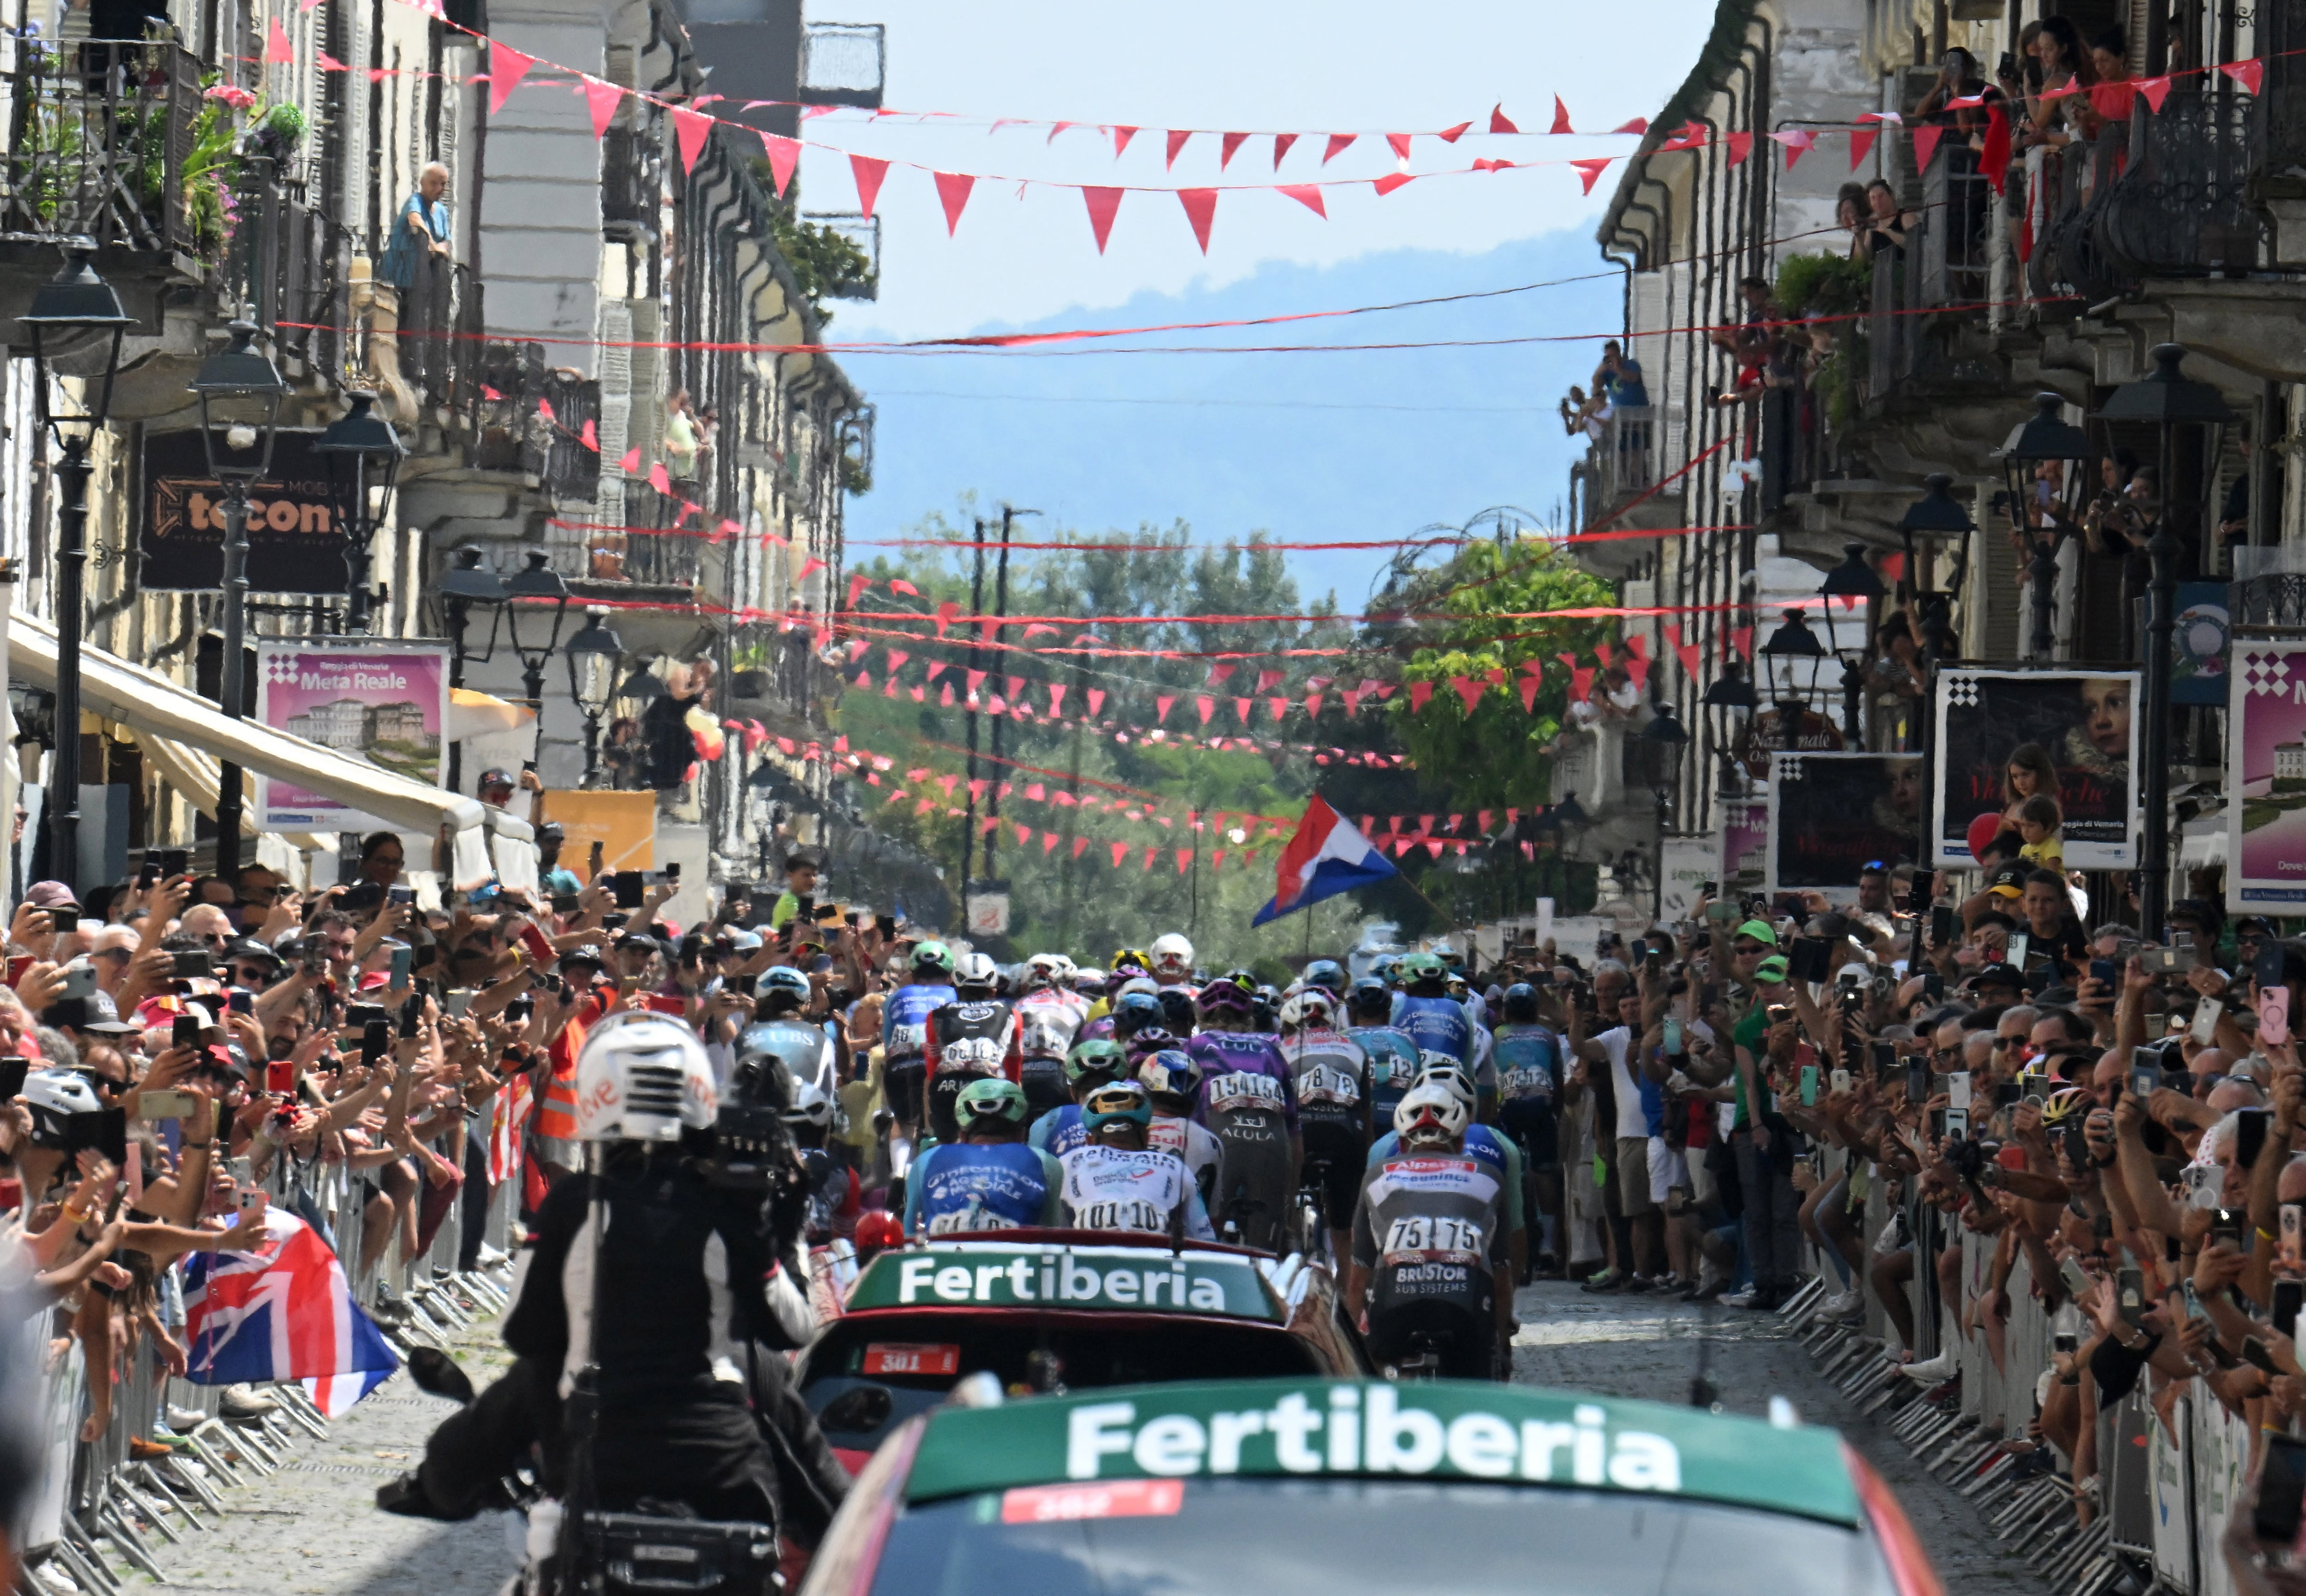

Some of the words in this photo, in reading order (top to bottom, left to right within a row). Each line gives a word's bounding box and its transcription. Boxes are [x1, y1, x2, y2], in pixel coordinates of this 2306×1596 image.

[301, 672, 350, 689] Meta
[355, 672, 406, 689] Reale
[770, 1030, 815, 1046] UBS
[1213, 1076, 1248, 1102] 154
[1304, 1068, 1323, 1092] 78
[1222, 1127, 1275, 1141] ALULA
[1394, 1222, 1421, 1249] 75
[1445, 1222, 1475, 1249] 75
[899, 1254, 1226, 1311] Fertiberia
[880, 1352, 920, 1372] 301
[1065, 1383, 1682, 1491] Fertiberia
